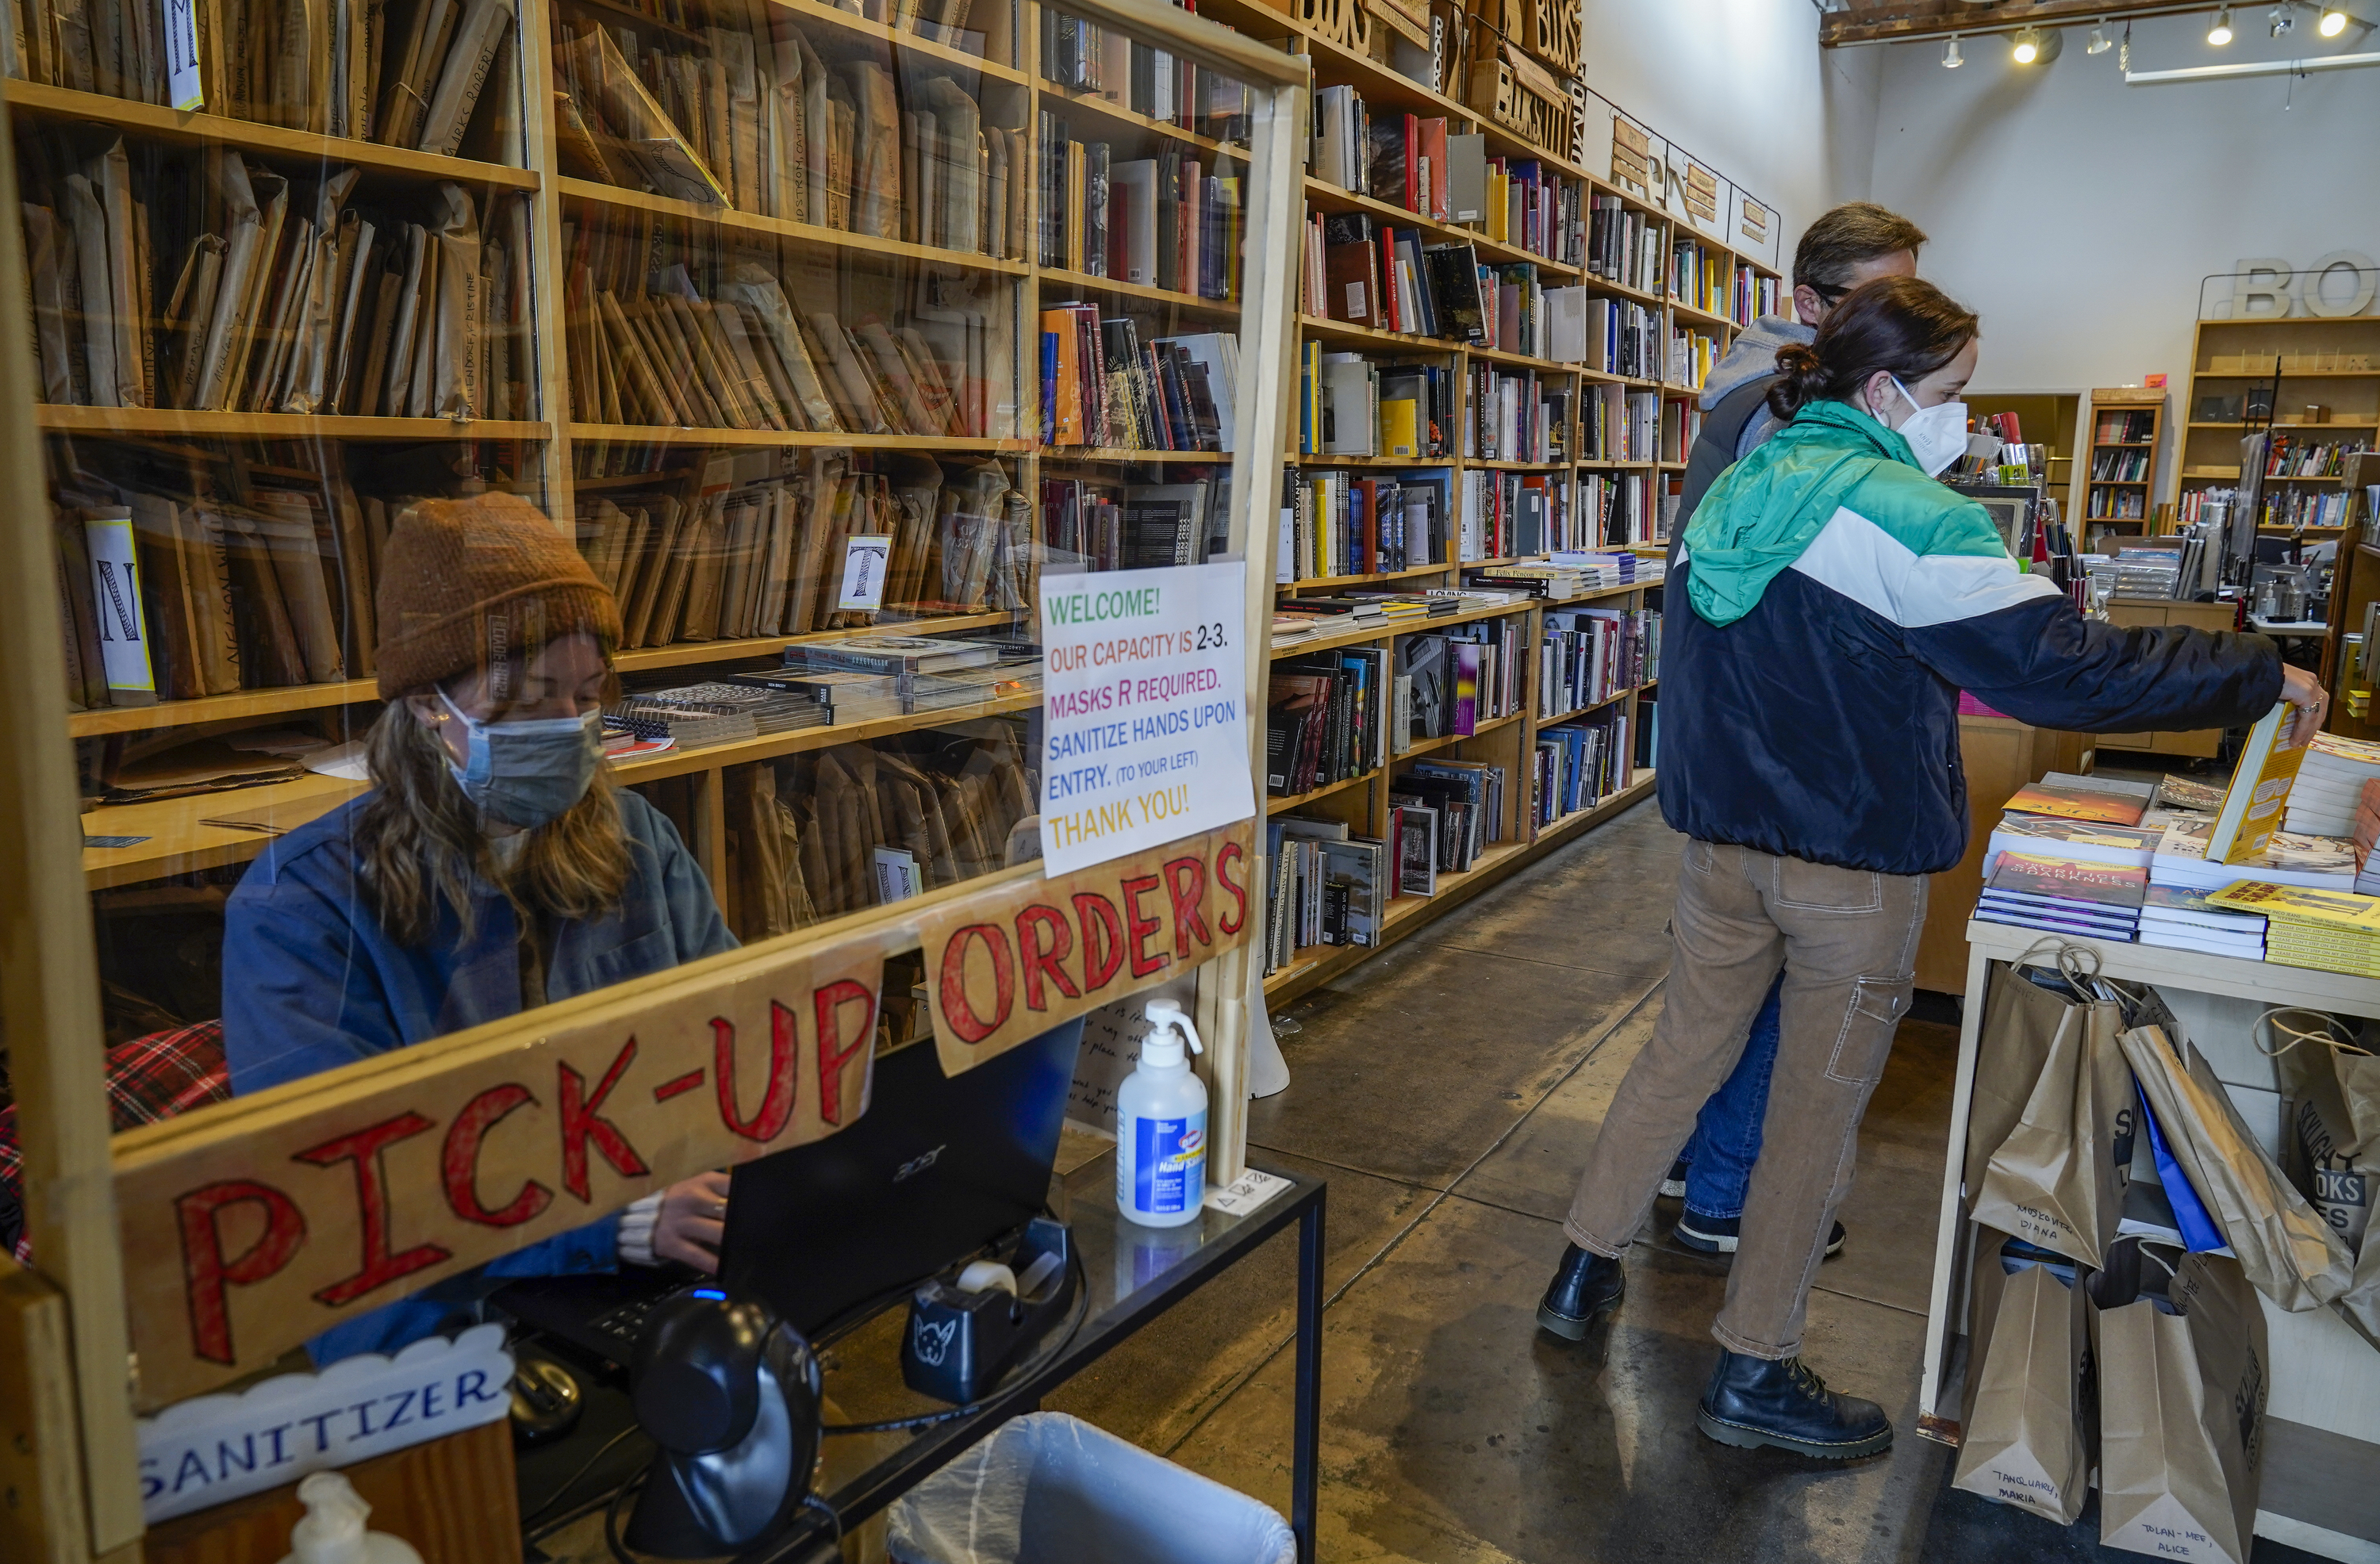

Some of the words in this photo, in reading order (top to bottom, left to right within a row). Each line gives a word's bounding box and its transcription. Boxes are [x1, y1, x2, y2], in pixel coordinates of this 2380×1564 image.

[1378, 3, 1422, 42] COLLECTIONS
[2231, 249, 2378, 318] BO
[850, 546, 887, 598] T
[1513, 569, 1535, 578] Fénéon
[97, 559, 140, 641] N
[1048, 588, 1161, 626] WELCOME!
[1050, 645, 1087, 673] OUR
[1093, 632, 1176, 666] CAPACITY
[1179, 630, 1192, 654] IS
[1197, 622, 1228, 651] 2-3.
[1050, 686, 1113, 721] MASKS
[1119, 679, 1132, 707] R
[1137, 668, 1222, 703] REQUIRED.
[1049, 722, 1129, 761] SANITIZE
[1134, 710, 1189, 743] HANDS
[1194, 700, 1236, 729] UPON
[1049, 764, 1111, 801] ENTRY.
[1115, 765, 1136, 787] (TO
[1138, 757, 1167, 780] YOUR
[1171, 749, 1199, 772] LEFT)
[1048, 799, 1134, 849] THANK
[1137, 784, 1190, 825] YOU!
[2013, 863, 2121, 882] SACRIFICE
[2025, 869, 2136, 888] DARKNESS
[1277, 877, 1288, 920] McCURRY
[938, 841, 1250, 1047] ORDERS
[1274, 922, 1283, 964] ANIMALS
[2301, 1099, 2363, 1175] SKYLIGHT
[178, 979, 877, 1367] PICK-UP
[1158, 1158, 1184, 1174] Hand
[2315, 1174, 2360, 1202] OKS
[2020, 1220, 2057, 1240] DIANA
[139, 1367, 501, 1499] SANITIZER
[1992, 1470, 2059, 1499] TANQUARY,
[1998, 1488, 2036, 1505] MARIA
[2158, 1542, 2190, 1556] ALICE
